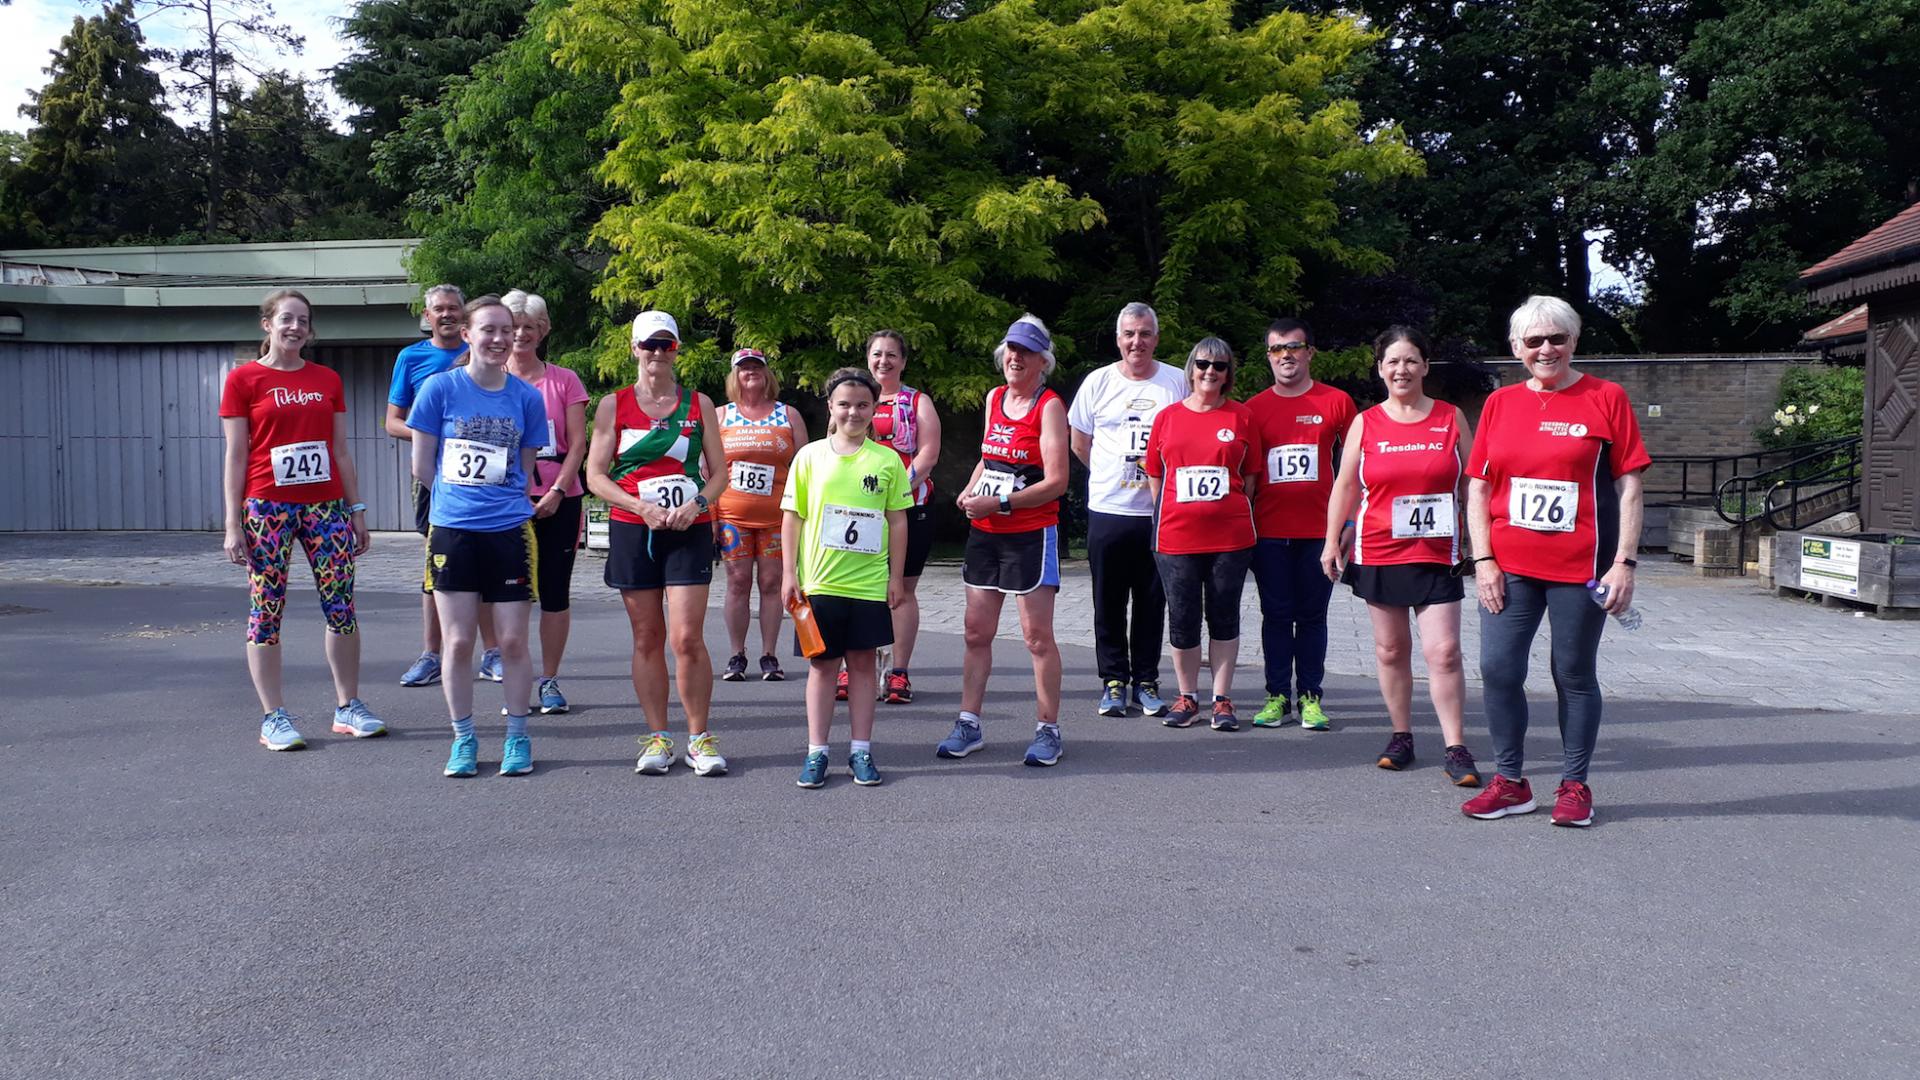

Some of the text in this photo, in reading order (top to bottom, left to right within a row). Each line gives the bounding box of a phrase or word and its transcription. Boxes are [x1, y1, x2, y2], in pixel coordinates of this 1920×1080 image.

[265, 387, 323, 408] Tikiboo
[677, 420, 697, 428] TAC
[1012, 449, 1029, 459] UK
[1377, 441, 1443, 453] Teesdale AC
[282, 453, 322, 479] 242
[458, 453, 487, 479] 32
[1278, 455, 1310, 477] 159
[740, 471, 766, 490] 185
[1189, 477, 1220, 497] 162
[657, 486, 683, 509] 30
[1521, 493, 1564, 523] 126
[1409, 507, 1436, 531] 44
[845, 520, 858, 545] 6
